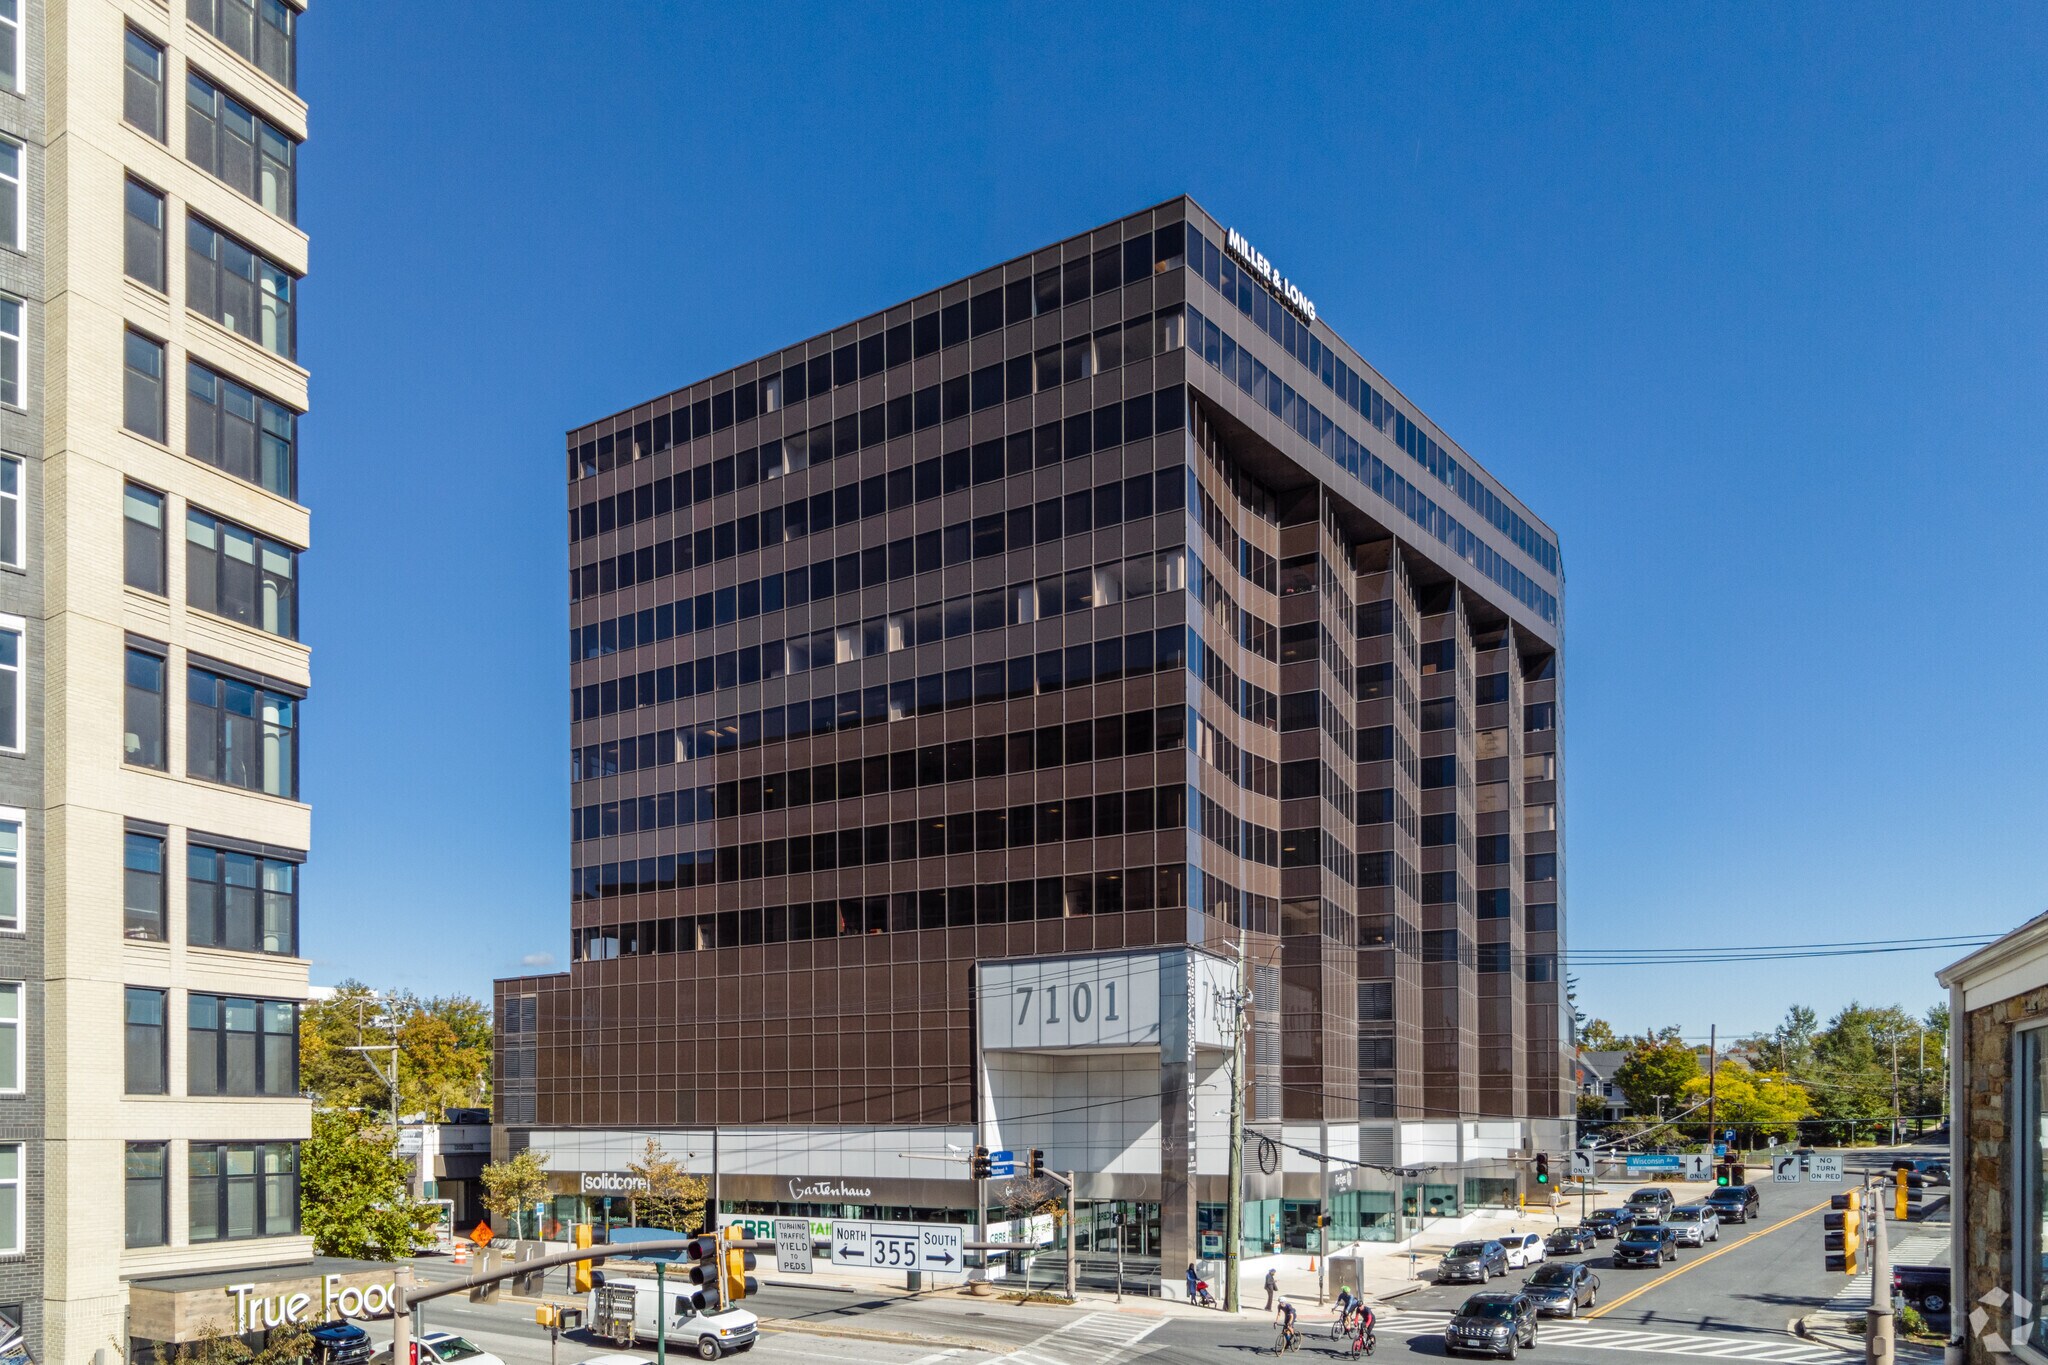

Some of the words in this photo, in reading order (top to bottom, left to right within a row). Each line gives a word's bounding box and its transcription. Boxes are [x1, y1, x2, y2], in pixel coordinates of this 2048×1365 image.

[1226, 226, 1272, 281] MILLER
[1272, 268, 1283, 292] &
[1284, 277, 1316, 321] LONG
[1016, 980, 1120, 1026] 7101
[1188, 1072, 1196, 1132] LEASE
[1725, 1131, 1734, 1139] P
[1632, 1157, 1665, 1165] Wisconsin
[788, 1176, 872, 1200] Gartenhaus
[731, 1219, 776, 1239] BR
[778, 1222, 806, 1230] TURNING
[836, 1227, 867, 1241] NORTH
[780, 1232, 805, 1240] TRAFFIC
[924, 1231, 957, 1247] SOUTH
[780, 1242, 808, 1251] YIELD
[874, 1239, 916, 1267] 355
[784, 1262, 806, 1270] PEDS
[226, 1283, 311, 1336] True
